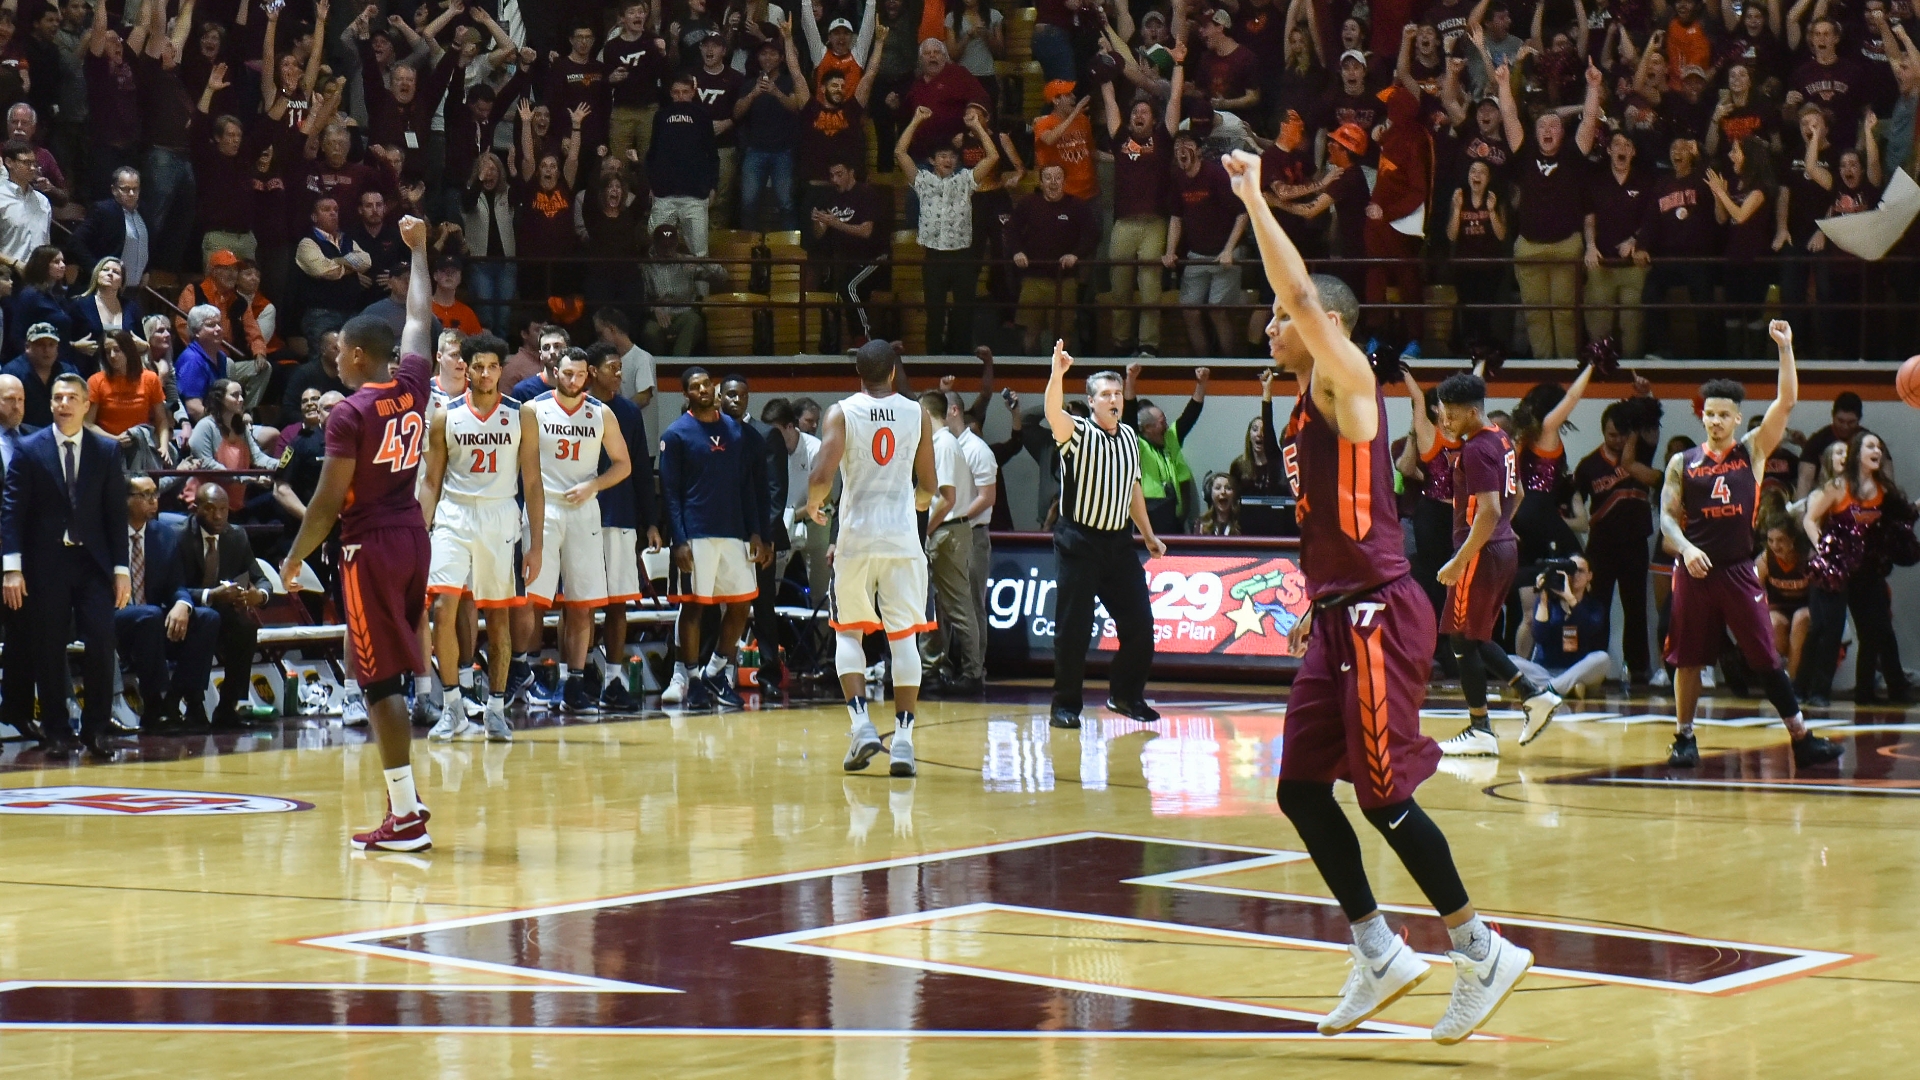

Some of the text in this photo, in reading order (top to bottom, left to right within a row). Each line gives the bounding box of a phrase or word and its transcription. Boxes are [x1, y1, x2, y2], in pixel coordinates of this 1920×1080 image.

[620, 50, 646, 66] VT
[698, 88, 725, 104] VT
[375, 392, 414, 417] OUTLAW
[869, 408, 896, 422] HALL
[454, 433, 512, 446] VIRGINIA
[543, 423, 597, 438] VIRGINIA
[372, 411, 423, 473] 42
[555, 438, 581, 461] 31
[871, 427, 896, 467] 0
[469, 448, 498, 473] 21
[1282, 442, 1300, 497] 5
[1687, 458, 1748, 479] VIRGINIA
[1710, 475, 1731, 504] 4
[1701, 503, 1743, 519] TECH
[1347, 602, 1387, 627] VT
[1177, 621, 1216, 641] Plan
